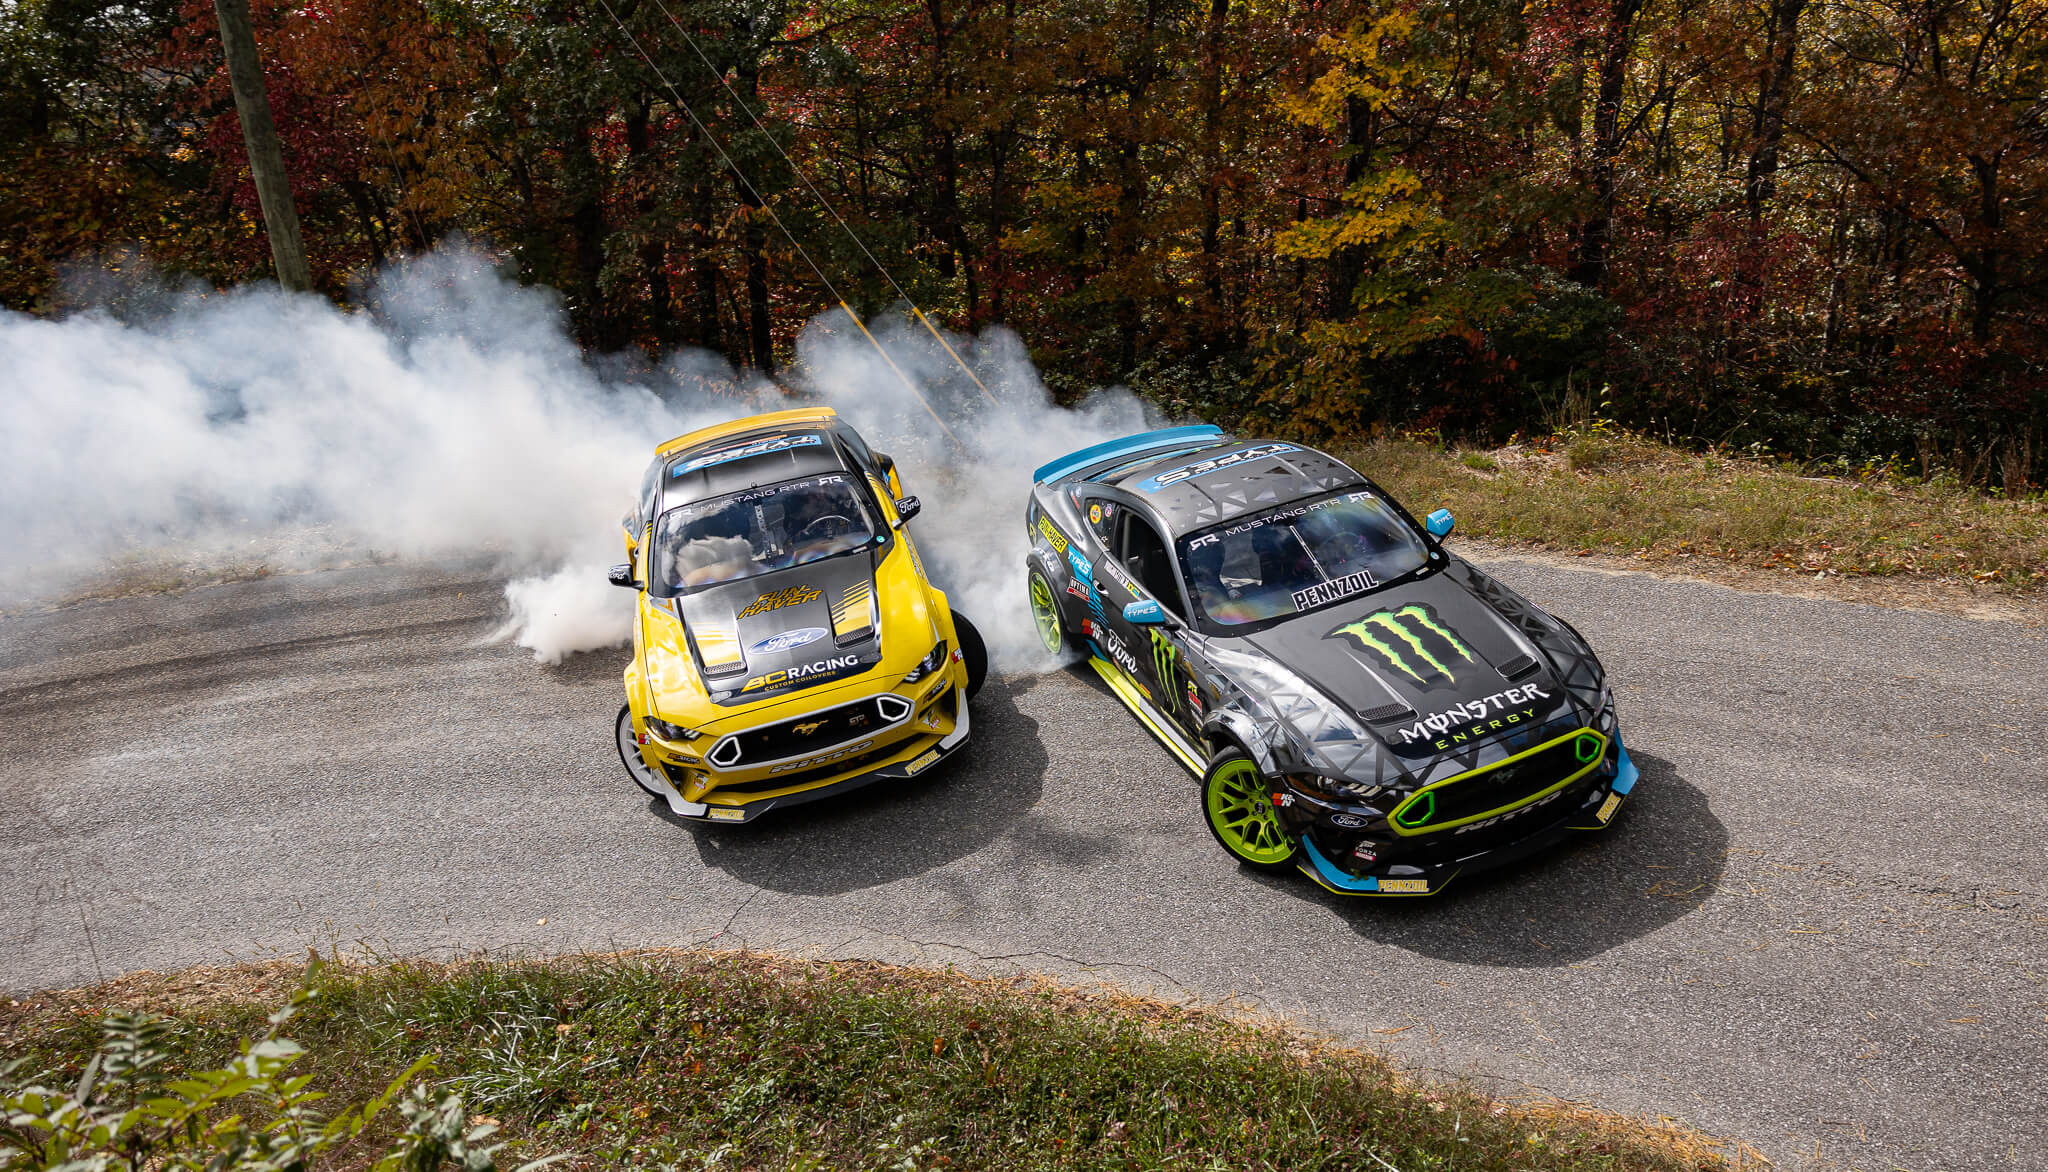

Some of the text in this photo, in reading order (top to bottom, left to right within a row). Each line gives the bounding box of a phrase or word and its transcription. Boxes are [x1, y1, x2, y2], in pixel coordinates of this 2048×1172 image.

[700, 482, 810, 513] MUSTANG RTR
[899, 498, 920, 514] Ford
[1225, 498, 1342, 537] MUSTANG RTR
[737, 589, 824, 620] HAVER
[1291, 570, 1379, 612] PENNZOIL
[764, 631, 812, 652] Ford
[1107, 628, 1139, 674] Ford
[764, 679, 795, 692] CUSTOM
[1398, 683, 1550, 744] MONSTER
[1435, 708, 1535, 751] ENERGY
[1337, 815, 1361, 826] Ford
[1378, 879, 1430, 893] PENNZOIL
